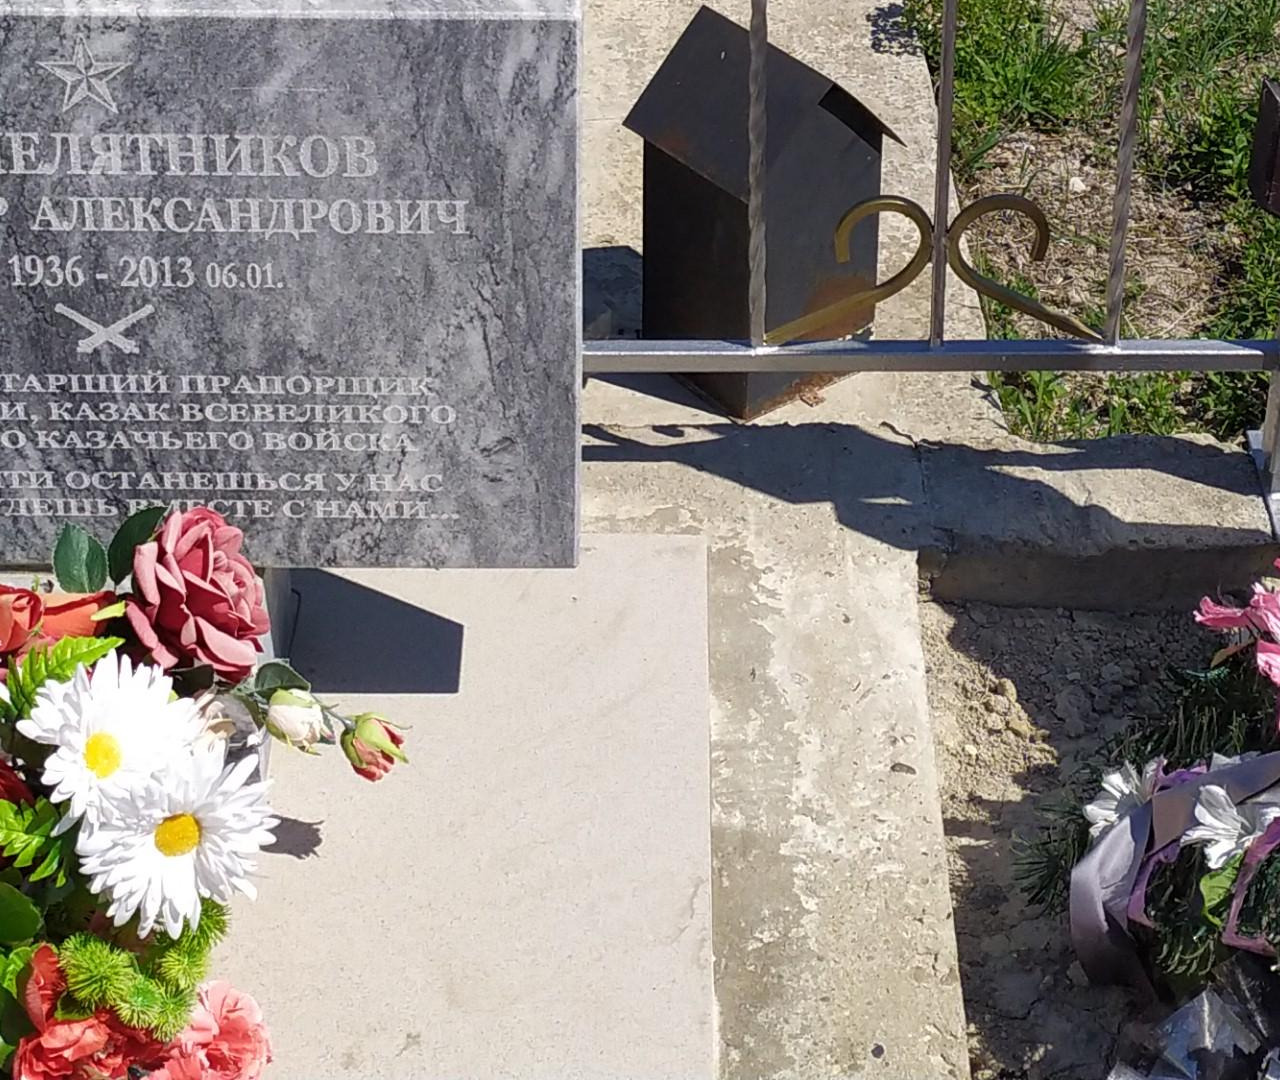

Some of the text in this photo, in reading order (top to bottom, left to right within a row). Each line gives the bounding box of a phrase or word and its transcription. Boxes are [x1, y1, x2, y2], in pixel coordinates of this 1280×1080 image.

[30, 196, 471, 241] АЛЕКСАНДРОВИЧ
[8, 253, 86, 287] 1936
[119, 255, 195, 289] 2013
[205, 261, 285, 289] 06.01.
[179, 374, 436, 399] ПРАПОРЩИК
[49, 402, 172, 421] КАЗАК
[180, 403, 458, 425] ВСЕВЕЛИКОГО
[37, 430, 255, 451] КАЗАЧЬЕГО
[264, 428, 420, 452] ВОЙСКА
[65, 471, 327, 491] ОСТАНЕШЬСЯ
[334, 473, 363, 492] У
[368, 473, 445, 492] НАС
[283, 500, 307, 518] С
